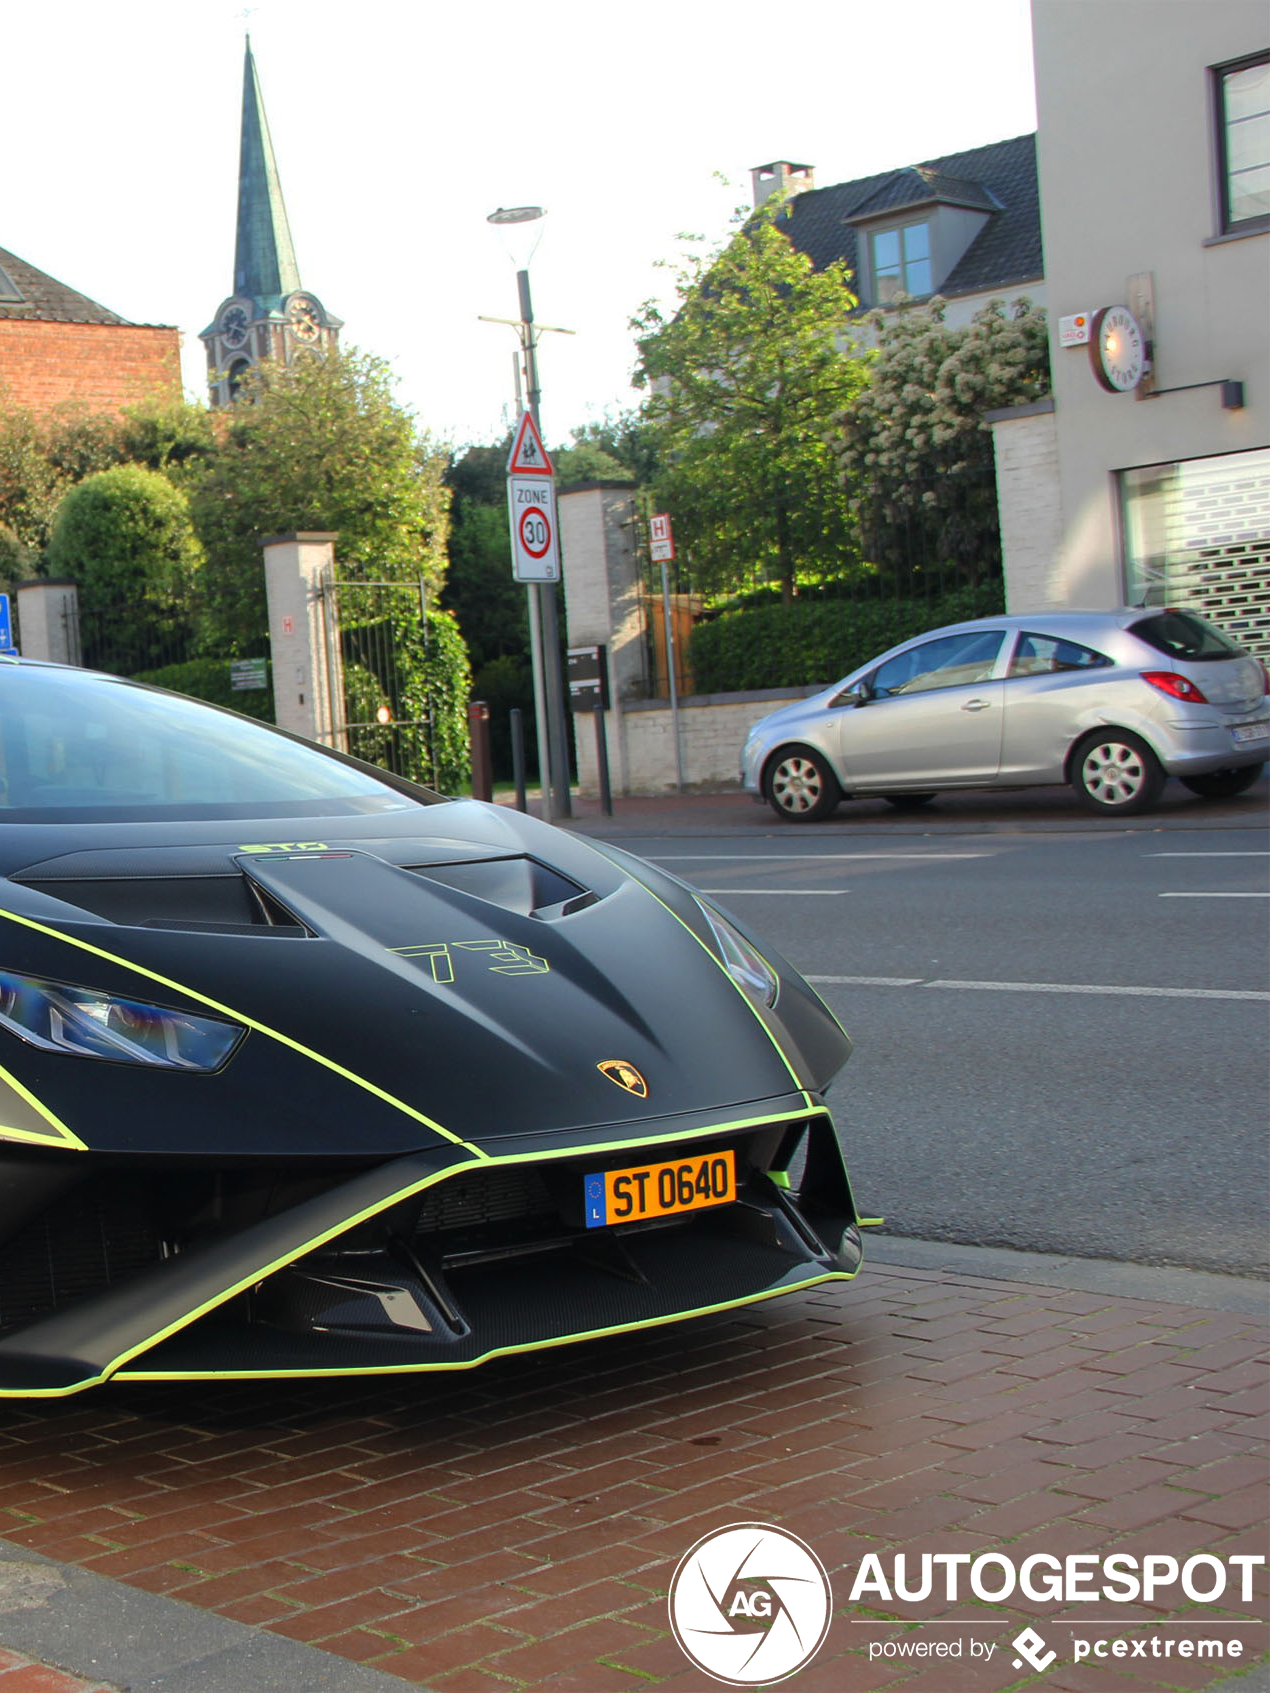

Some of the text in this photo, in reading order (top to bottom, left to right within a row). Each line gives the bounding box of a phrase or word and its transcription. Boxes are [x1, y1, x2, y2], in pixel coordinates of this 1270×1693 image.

[516, 488, 548, 505] ZONE
[525, 521, 545, 545] 30
[653, 519, 664, 537] H
[237, 841, 329, 853] STO
[385, 939, 551, 984] 73
[613, 1158, 728, 1217] ST 0640
[592, 1208, 600, 1219] L
